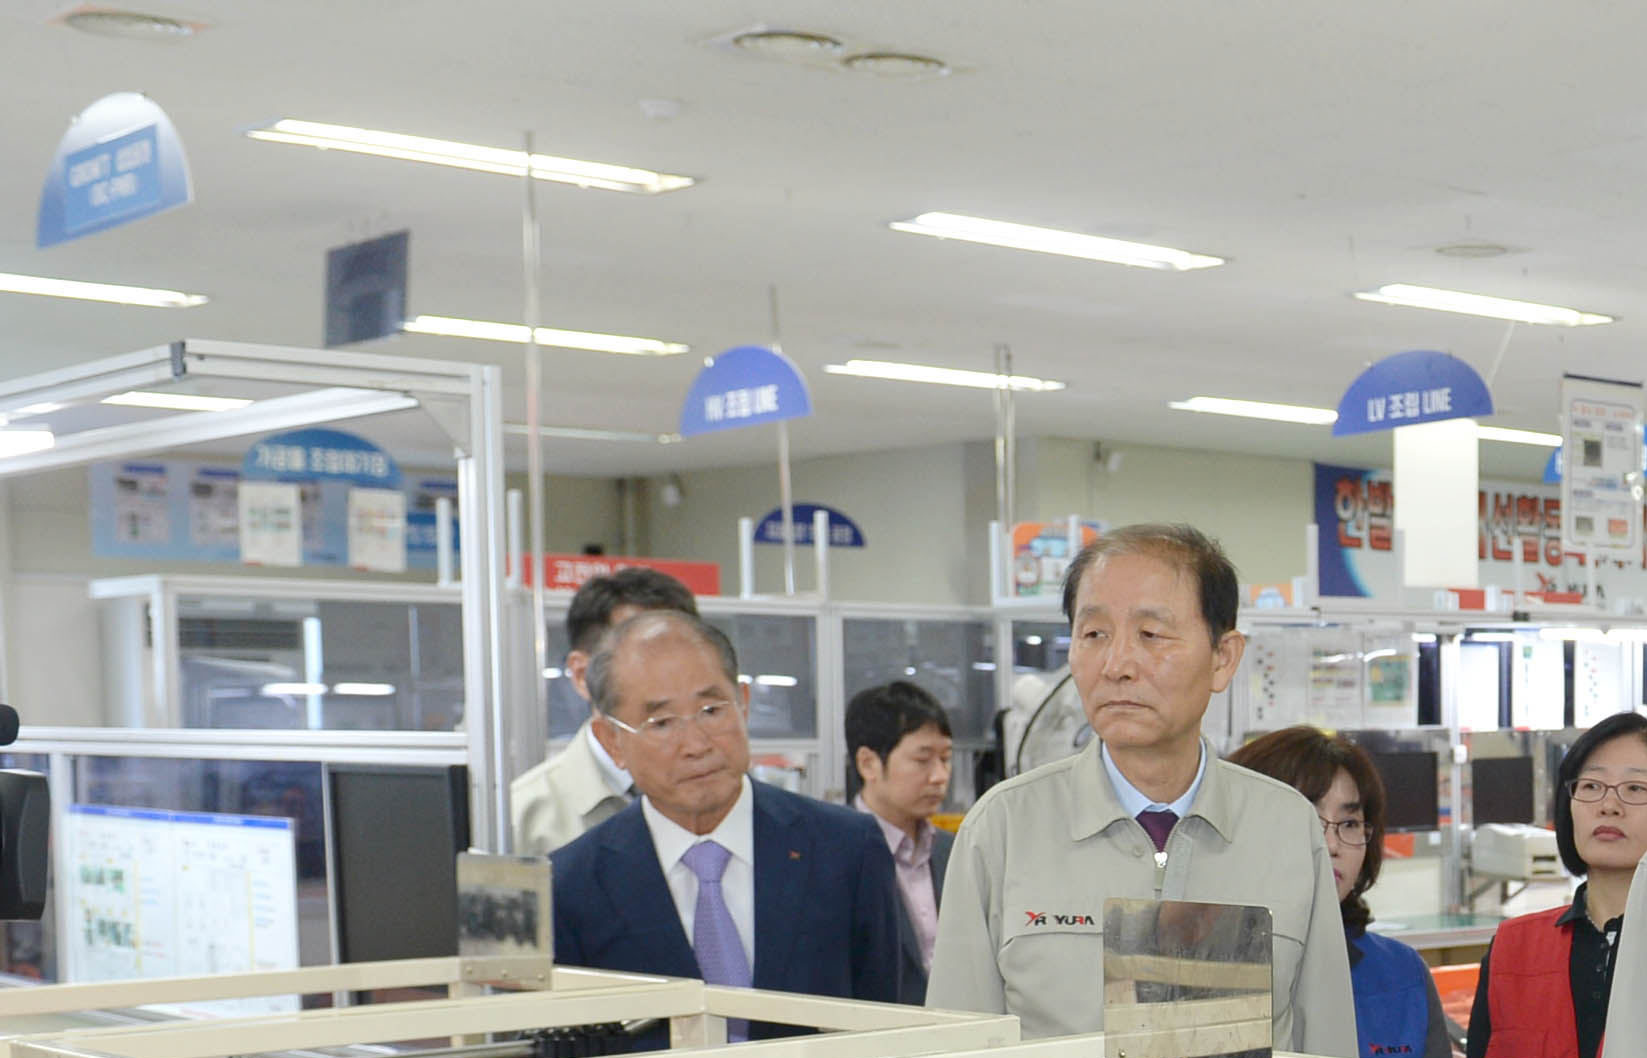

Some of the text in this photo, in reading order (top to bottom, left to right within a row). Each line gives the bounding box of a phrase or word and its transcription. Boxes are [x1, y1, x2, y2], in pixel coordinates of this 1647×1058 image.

[1367, 387, 1452, 423] LV 조립 LINE
[1479, 490, 1562, 566] 선활동
[1053, 914, 1095, 926] YURA
